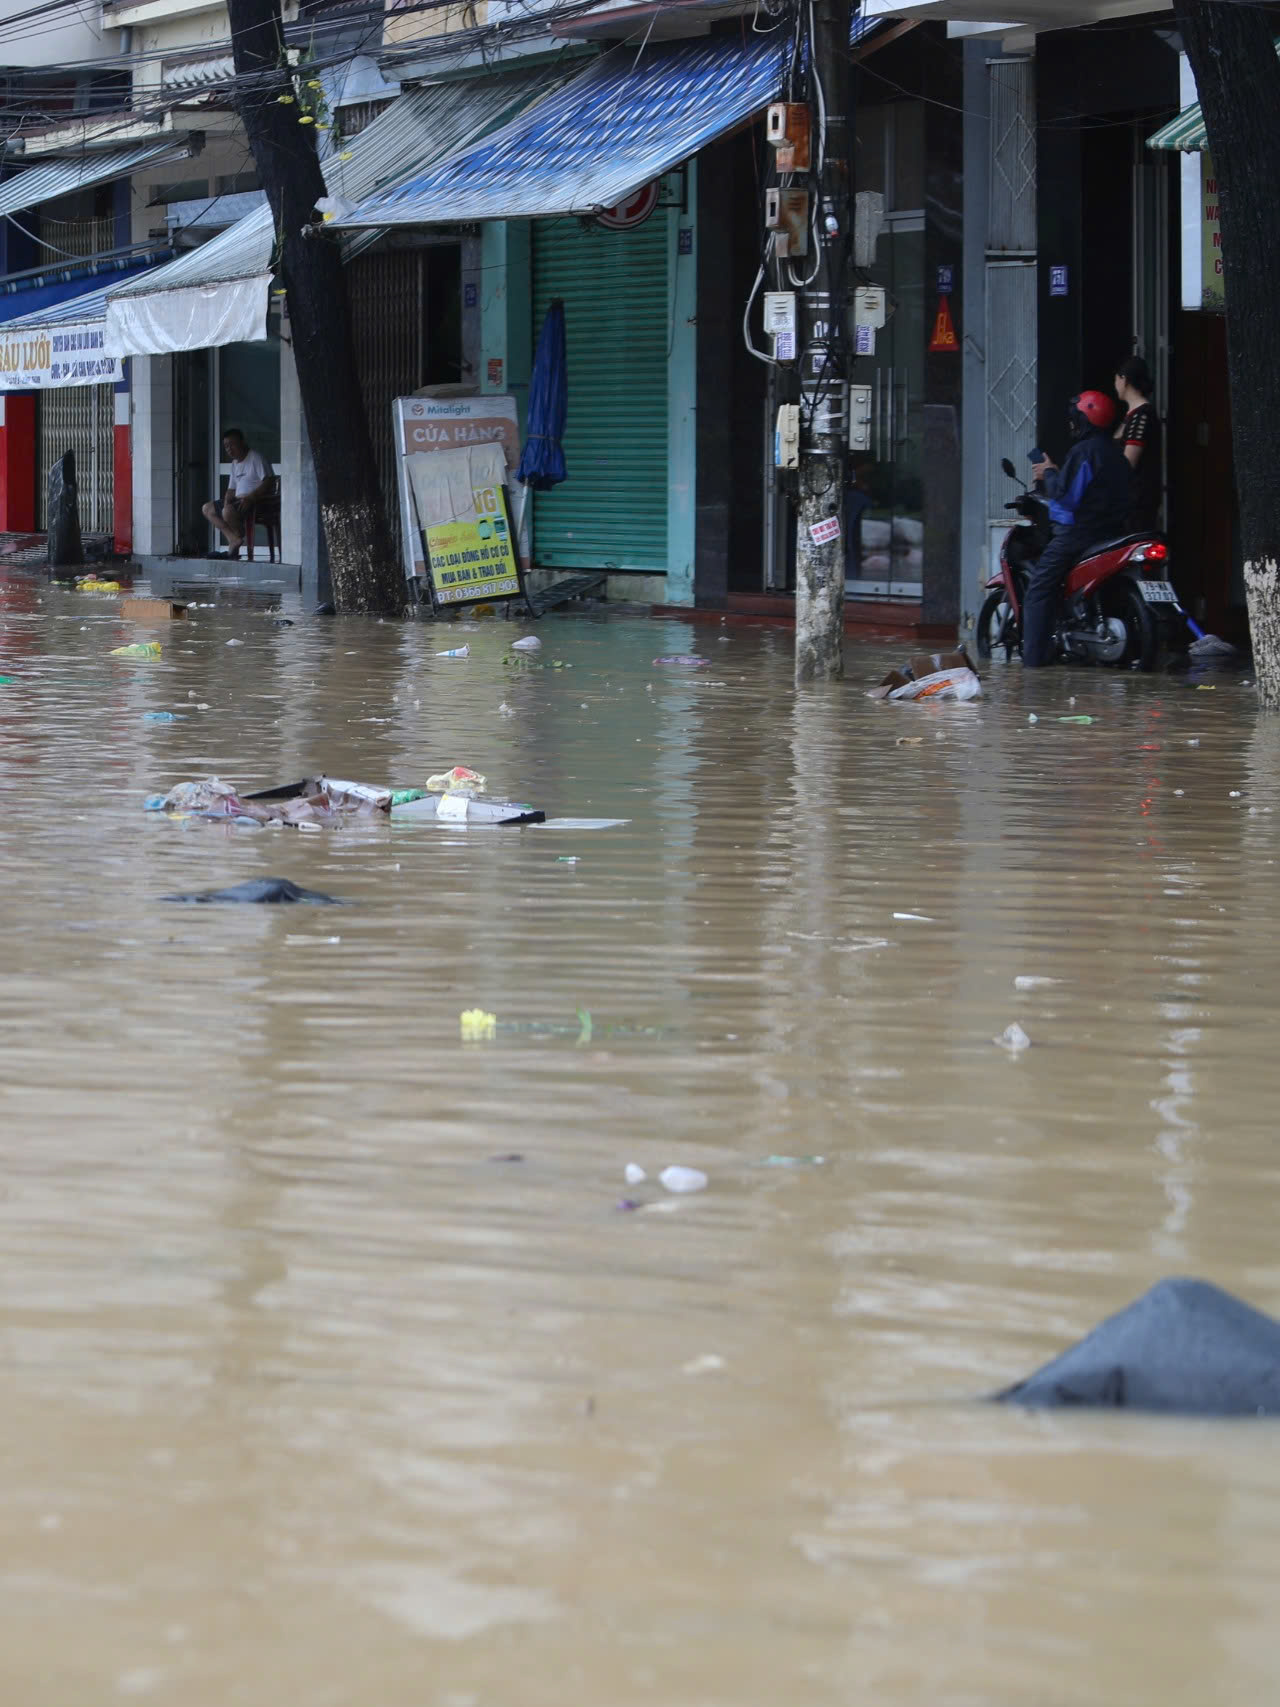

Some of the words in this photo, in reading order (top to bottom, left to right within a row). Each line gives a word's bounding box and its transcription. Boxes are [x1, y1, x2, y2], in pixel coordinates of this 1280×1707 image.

[22, 332, 51, 370] LƯỚI
[427, 404, 470, 416] Mitalight
[412, 424, 449, 443] CỬA
[454, 424, 506, 442] HÀNG
[431, 554, 446, 569] CÁC
[441, 571, 456, 584] MUA
[472, 567, 478, 579] &
[478, 564, 495, 578] TRAO
